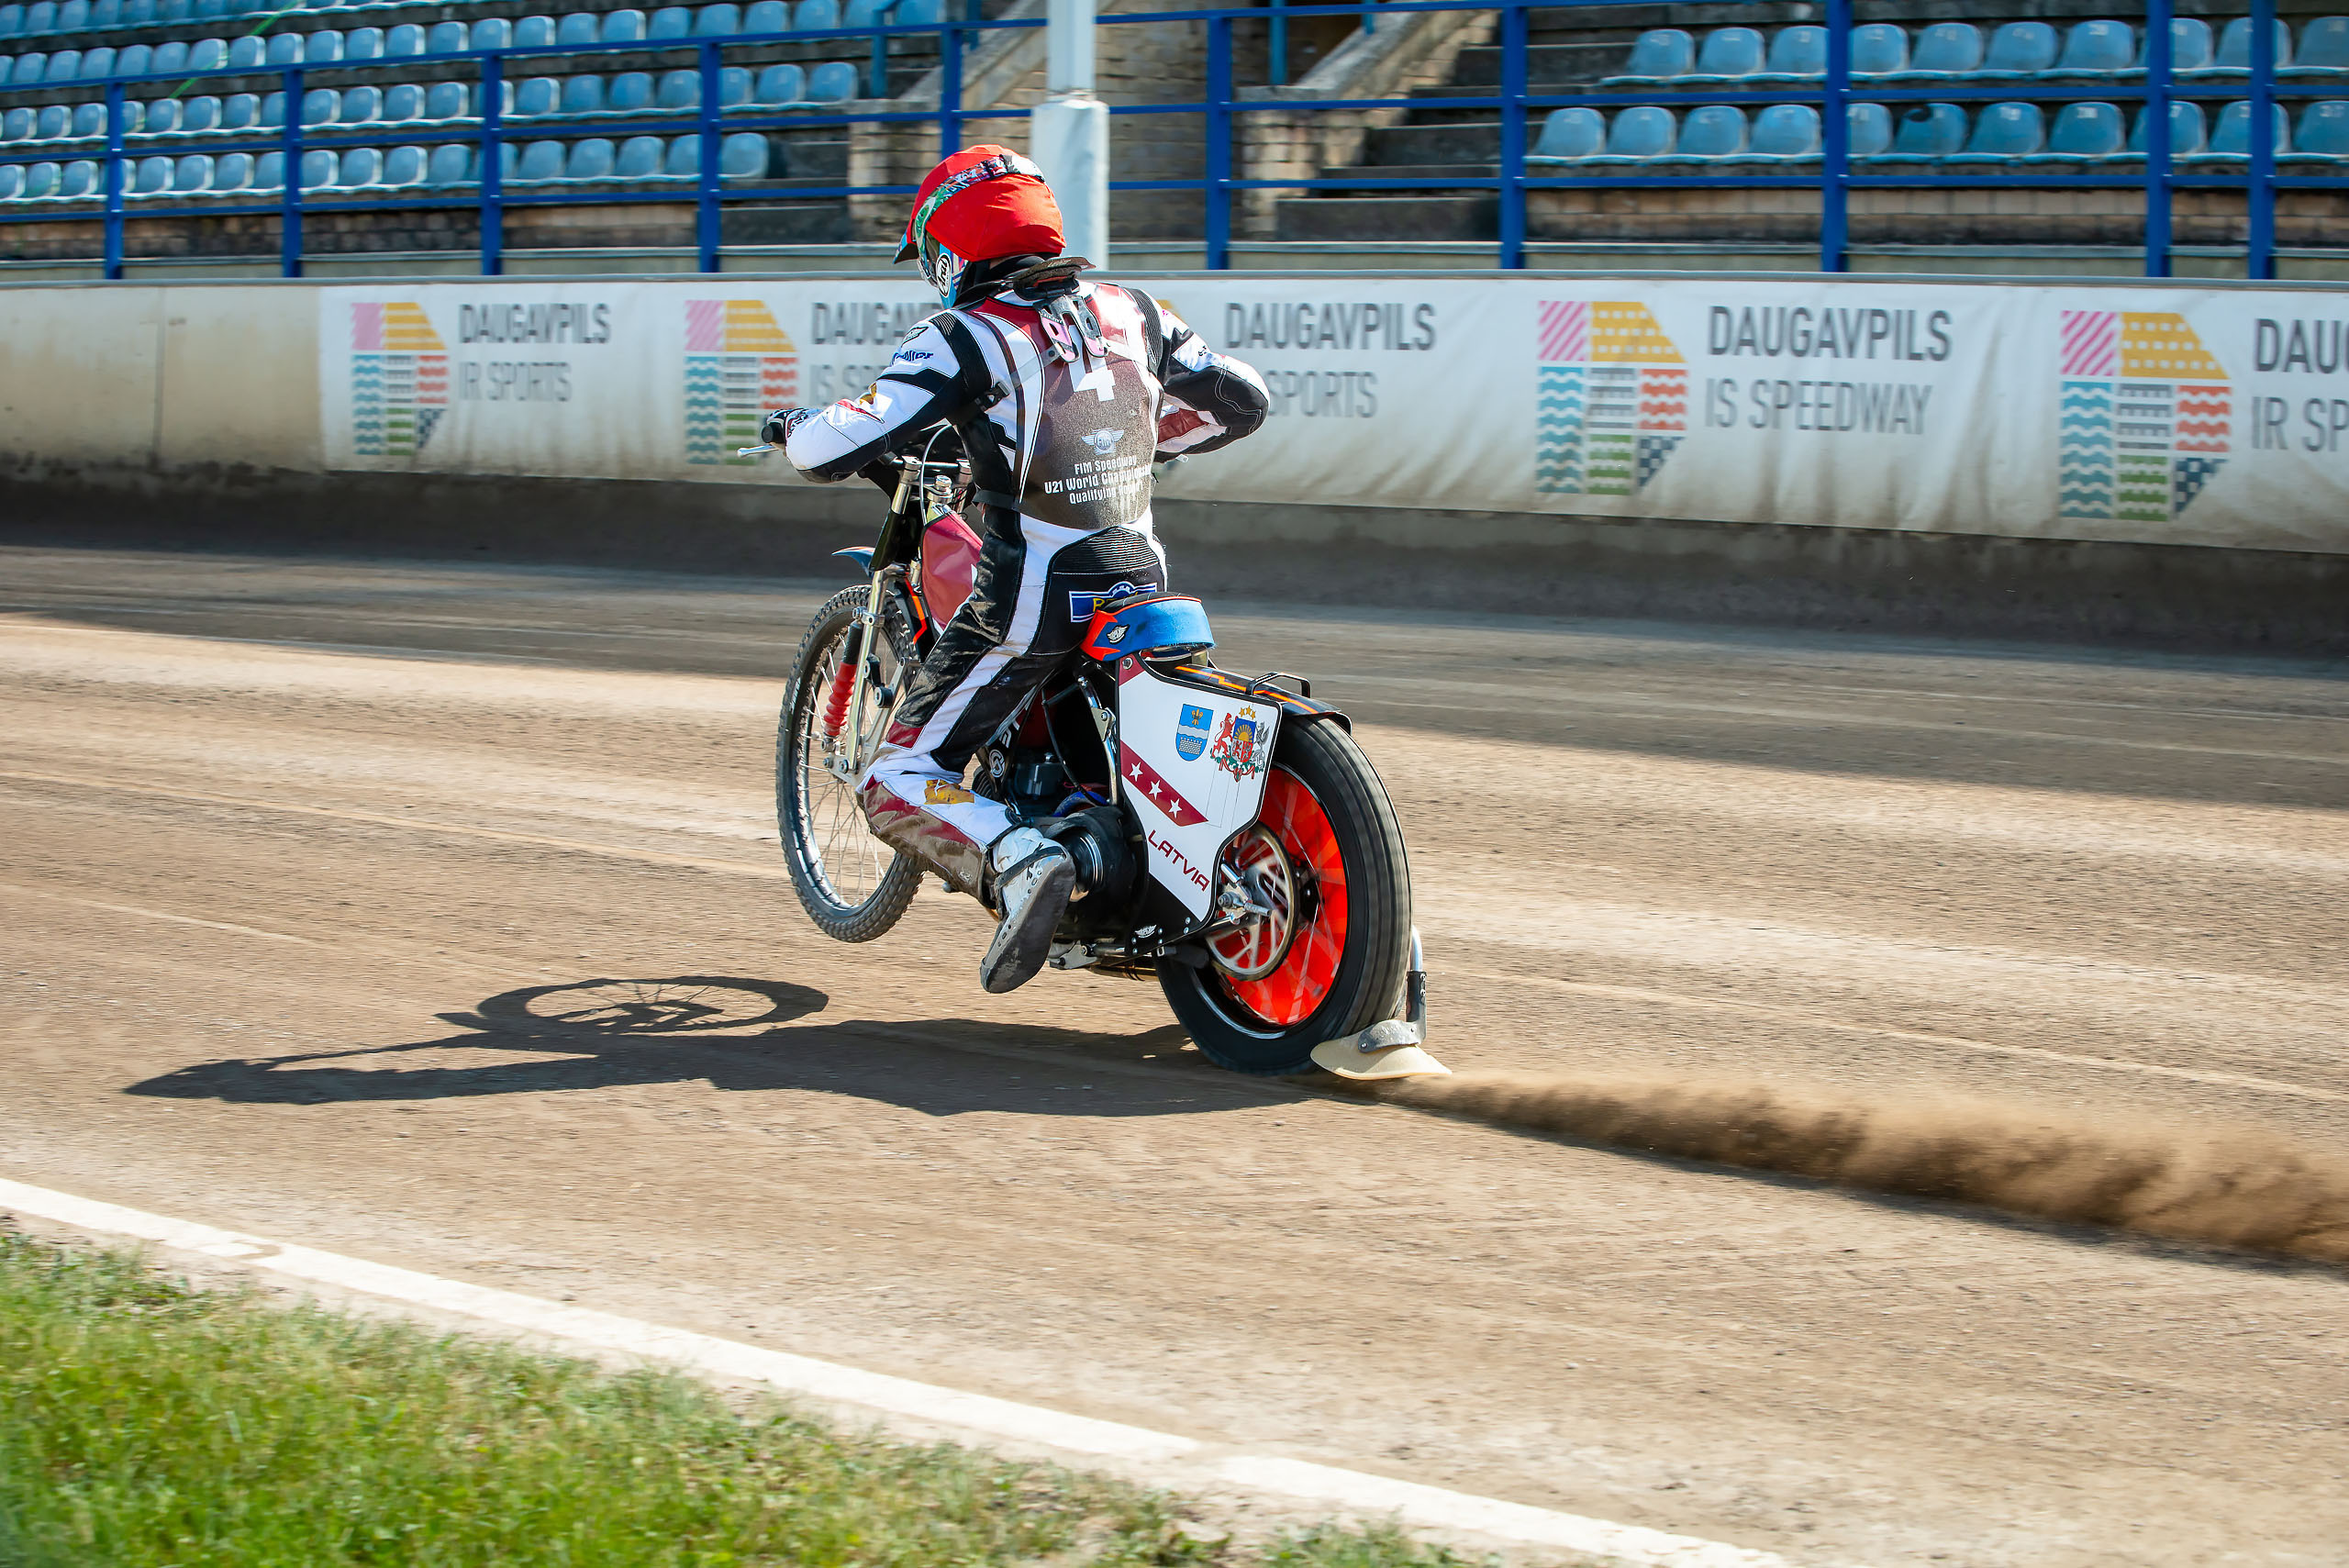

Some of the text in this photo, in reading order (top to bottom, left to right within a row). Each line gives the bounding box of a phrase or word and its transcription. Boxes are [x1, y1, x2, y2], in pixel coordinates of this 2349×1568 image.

[459, 304, 612, 343] DAUGAVPILS
[1225, 303, 1438, 350] DAUGAVPILS
[1708, 306, 1954, 361] DAUGAVPILS
[459, 361, 573, 403] IR SPORTS
[1264, 370, 1380, 418] SPORTS
[1704, 378, 1933, 435] IS SPEEDWAY
[2251, 396, 2289, 450] IR
[1044, 479, 1063, 495] U21
[1065, 473, 1099, 492] World
[1074, 455, 1138, 475] FIM Speedway
[1069, 486, 1117, 505] Qualifying
[1148, 829, 1210, 892] LATVIA
